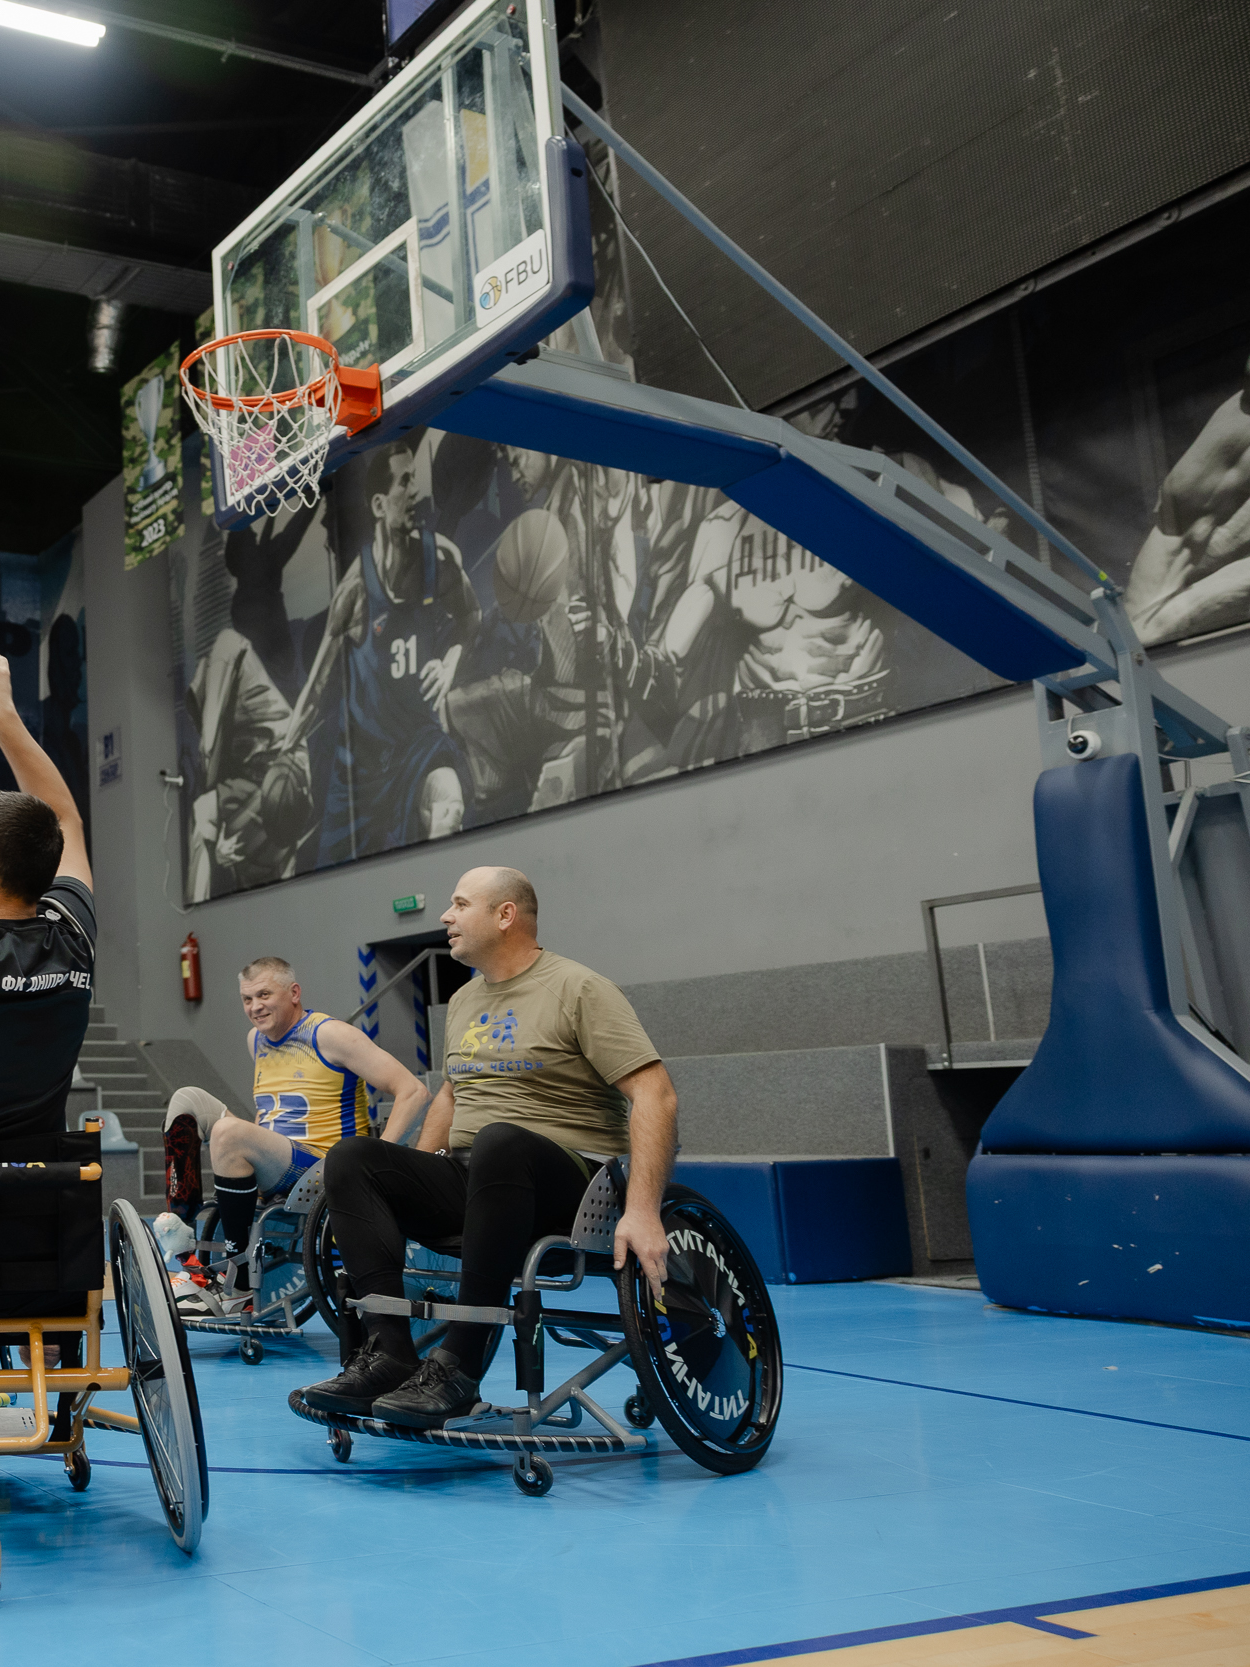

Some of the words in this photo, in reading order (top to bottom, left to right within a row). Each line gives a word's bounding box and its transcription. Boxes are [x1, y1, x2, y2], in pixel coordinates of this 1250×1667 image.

[504, 248, 543, 294] FBU
[141, 518, 167, 548] 2023
[390, 634, 417, 679] 31
[1, 974, 26, 992] ФК
